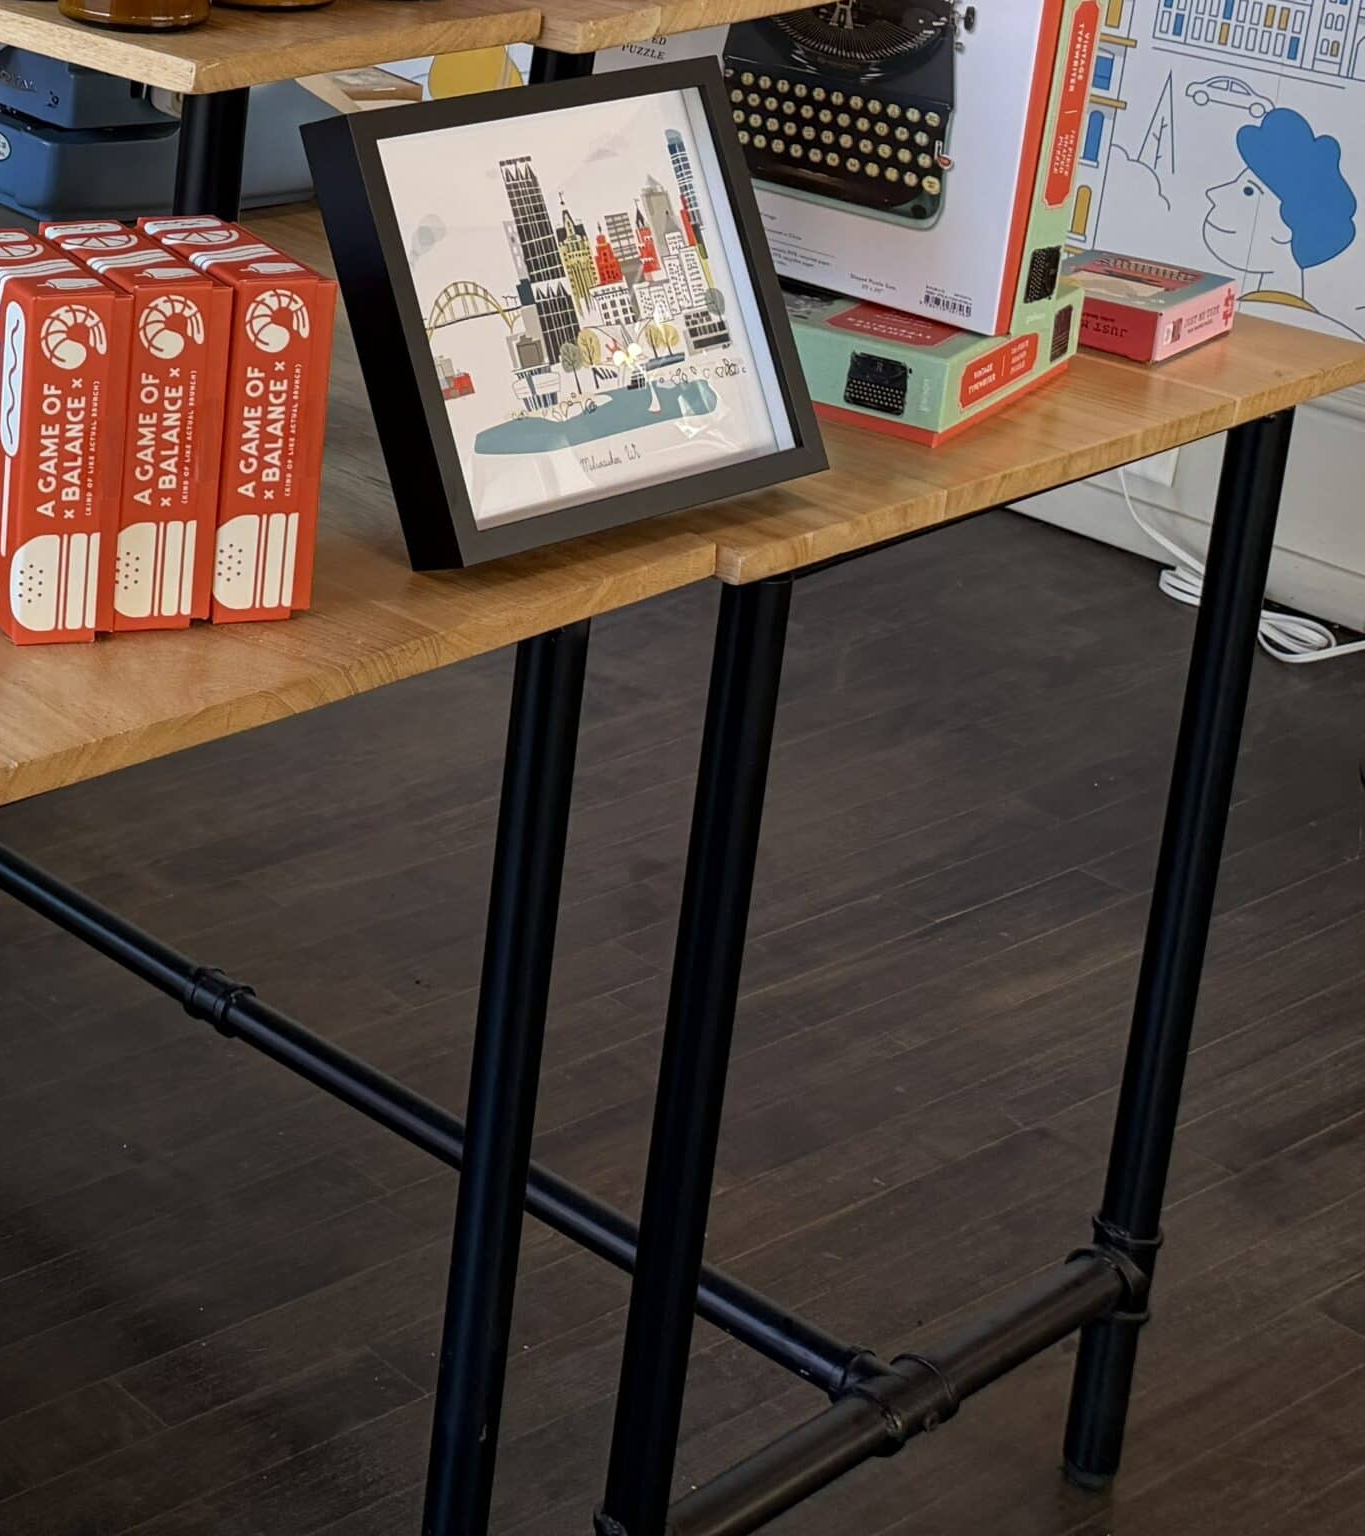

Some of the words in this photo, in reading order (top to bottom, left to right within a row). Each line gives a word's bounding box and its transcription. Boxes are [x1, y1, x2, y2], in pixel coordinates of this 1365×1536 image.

[622, 42, 666, 60] PUZZLE
[1069, 24, 1086, 92] TYPEWRITER
[1077, 32, 1090, 81] VINTAGE
[140, 372, 161, 404] OF
[246, 366, 266, 399] OF
[973, 363, 993, 381] VINTAGE
[42, 382, 63, 415] OF
[61, 396, 86, 501] BALANCE
[134, 413, 158, 482] GAME
[158, 384, 184, 489] BALANCE
[239, 401, 263, 474] GAME
[261, 378, 289, 483] BALANCE
[37, 423, 62, 494] GAME
[133, 488, 153, 506] A
[237, 480, 256, 498] A
[37, 502, 55, 518] A
